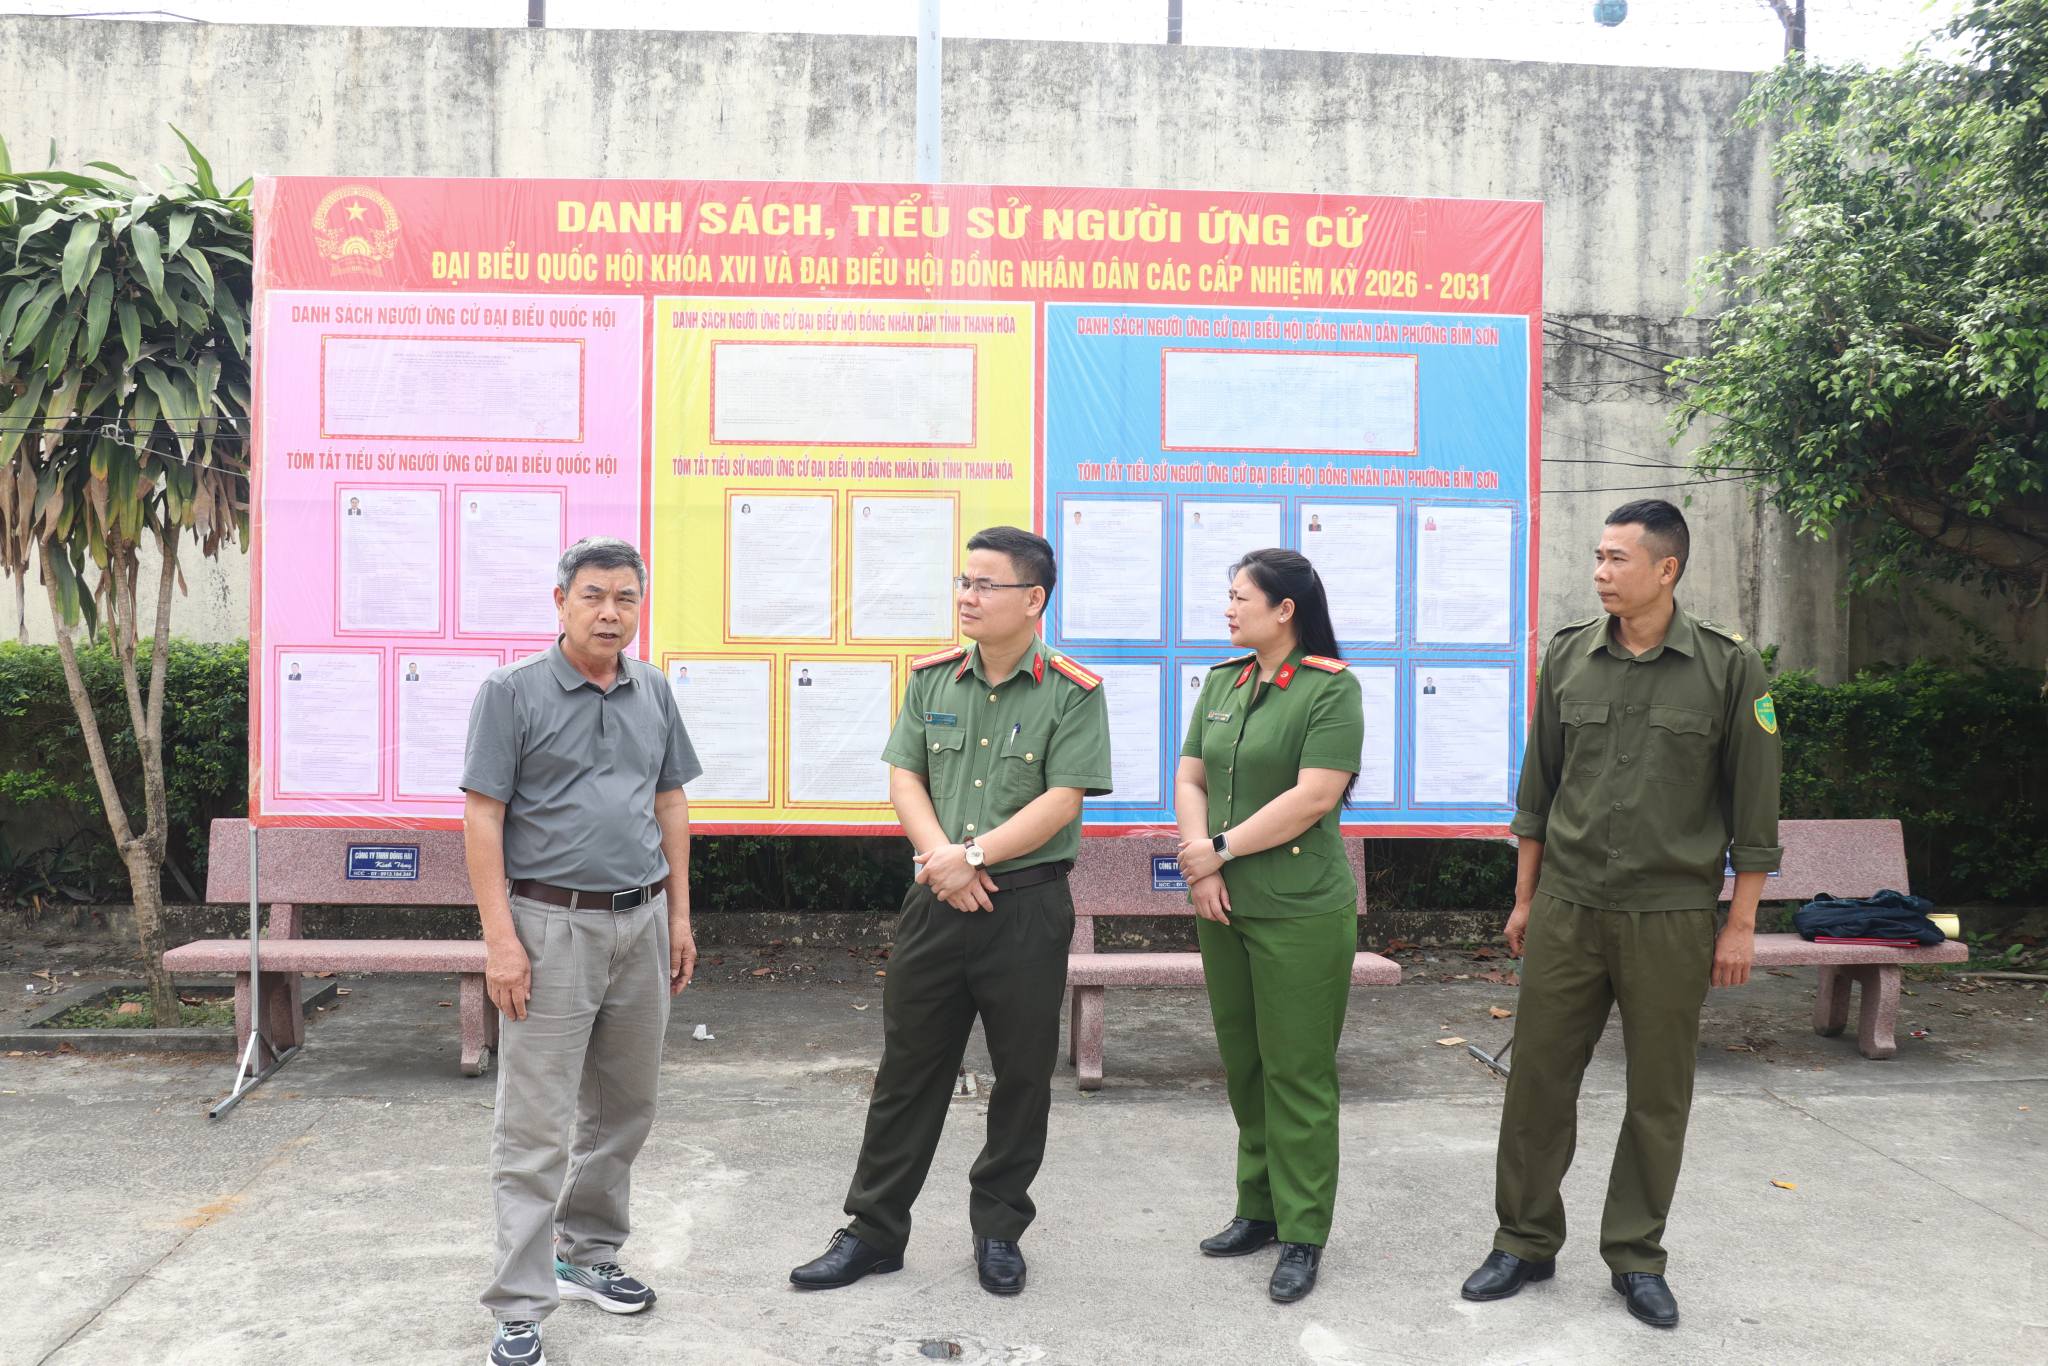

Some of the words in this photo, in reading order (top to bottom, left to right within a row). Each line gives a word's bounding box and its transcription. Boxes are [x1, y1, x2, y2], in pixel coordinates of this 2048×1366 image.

[557, 201, 682, 233] DANH
[699, 196, 836, 240] SÁCH,
[851, 193, 950, 237] TIỂU
[966, 196, 1032, 239] SỬ
[1042, 203, 1181, 242] NGƯỜI
[1198, 206, 1289, 246] ỨNG
[1306, 206, 1369, 248] CỬ
[432, 252, 470, 285] ĐẠI
[478, 241, 529, 281] BIỂU
[538, 244, 598, 282] QUỐC
[606, 248, 643, 288] HỘI
[650, 249, 712, 282] KHÓA
[720, 256, 756, 283] XVI
[764, 251, 794, 284] VÀ
[800, 256, 838, 290] ĐẠI
[846, 247, 898, 287] BIỂU
[906, 252, 944, 292] HỘI
[951, 252, 1013, 288] ĐỒNG
[1021, 259, 1085, 289] NHÂN
[1092, 260, 1139, 290] DÂN
[1147, 259, 1191, 291] CÁC
[1199, 256, 1243, 292] CẤP
[1251, 263, 1323, 299] NHIỆM
[1331, 263, 1359, 295] KỲ
[1365, 269, 1417, 297] 2026
[1440, 273, 1490, 300] 2031
[292, 306, 330, 323] DANH
[336, 303, 372, 323] SÁCH
[378, 304, 420, 324] NGƯỜI
[426, 304, 455, 325] ỨNG
[460, 303, 480, 324] CỬ
[484, 309, 506, 329] ĐẠI
[513, 303, 544, 326] BIỂU
[550, 304, 587, 327] QUỐC
[592, 307, 616, 330] HỘI
[673, 311, 698, 328] DANH
[701, 309, 725, 329] SÁCH
[729, 309, 757, 329] NGƯỜI
[761, 309, 780, 329] ỨNG
[783, 308, 796, 330] CỬ
[799, 313, 813, 334] ĐẠI
[817, 307, 837, 330] BIỂU
[841, 310, 856, 335] HỘI
[860, 309, 884, 331] ĐỒNG
[888, 312, 914, 332] NHÂN
[917, 312, 936, 332] DÂN
[940, 309, 960, 332] TỈNH
[964, 315, 993, 333] THANH
[997, 313, 1016, 333] HÓA
[1076, 316, 1109, 337] DANH
[1112, 314, 1144, 337] SÁCH
[1147, 315, 1183, 337] NGƯỜI
[1186, 315, 1210, 338] ỨNG
[1213, 313, 1230, 338] CỬ
[1232, 318, 1251, 343] ĐẠI
[1254, 313, 1280, 339] BIỂU
[1283, 317, 1303, 344] HỘI
[1306, 317, 1337, 341] ĐỒNG
[1340, 320, 1372, 342] NHÂN
[1375, 321, 1398, 342] DÂN
[1402, 322, 1447, 344] PHƯỜNG
[1450, 321, 1472, 345] BỈM
[1475, 326, 1499, 345] SƠN
[287, 449, 314, 469] TÓM
[319, 446, 341, 469] TẮT
[346, 446, 373, 470] TIỂU
[378, 448, 396, 470] SỬ
[399, 451, 439, 471] NGƯỜI
[443, 451, 470, 471] ỨNG
[475, 450, 493, 472] CỬ
[496, 456, 518, 476] ĐẠI
[522, 450, 552, 474] BIỂU
[557, 451, 591, 475] QUỐC
[596, 454, 617, 478] HỘI
[673, 454, 691, 475] TÓM
[712, 452, 730, 476] TIỂU
[733, 454, 745, 476] SỬ
[747, 456, 774, 477] NGƯỜI
[777, 456, 795, 477] ỨNG
[797, 454, 810, 477] CỬ
[811, 460, 826, 481] ĐẠI
[829, 454, 848, 477] BIỂU
[851, 457, 865, 482] HỘI
[868, 456, 892, 478] ĐỒNG
[895, 458, 920, 478] NHÂN
[922, 458, 940, 479] DÂN
[942, 456, 962, 479] TỈNH
[965, 462, 993, 479] THANH
[996, 459, 1013, 480] HÓA
[1078, 459, 1101, 481] TÓM
[1126, 457, 1149, 481] TIỂU
[1152, 459, 1169, 482] SỬ
[1171, 460, 1203, 483] NGƯỜI
[1206, 460, 1229, 483] ỨNG
[1232, 459, 1247, 484] CỬ
[1249, 465, 1268, 488] ĐẠI
[1271, 460, 1295, 484] BIỂU
[1297, 464, 1316, 489] HỘI
[1319, 461, 1347, 486] ĐỒNG
[1351, 465, 1380, 486] NHÂN
[1383, 465, 1405, 487] DÂN
[1408, 466, 1450, 488] PHƯỜNG
[1453, 464, 1474, 488] BỈM
[1477, 471, 1499, 489] SƠN
[369, 852, 376, 860] TY
